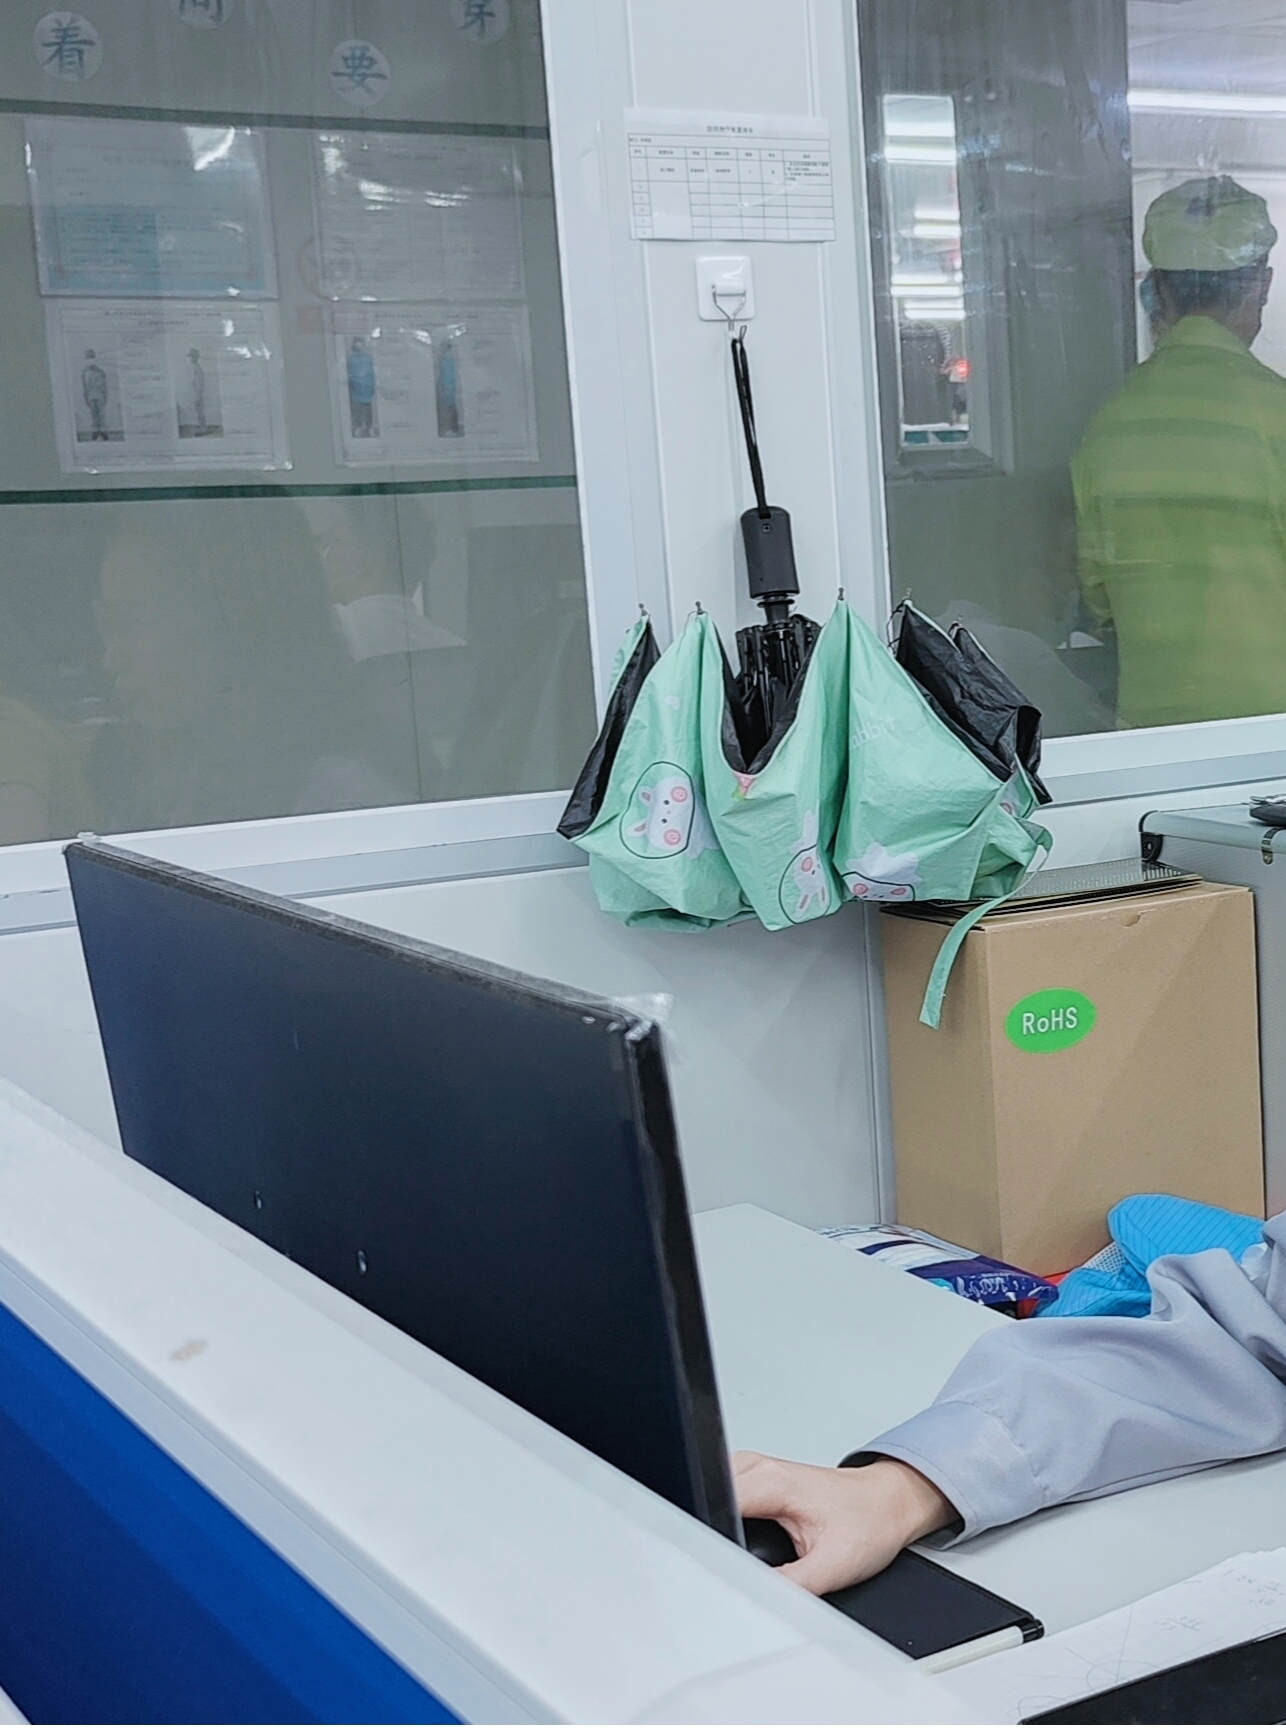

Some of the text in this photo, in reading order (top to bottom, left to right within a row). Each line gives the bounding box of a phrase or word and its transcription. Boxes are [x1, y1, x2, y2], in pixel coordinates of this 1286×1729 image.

[41, 17, 97, 80] 着
[331, 45, 389, 95] 要
[851, 715, 896, 749] abbit
[1022, 1006, 1078, 1035] RoHS
